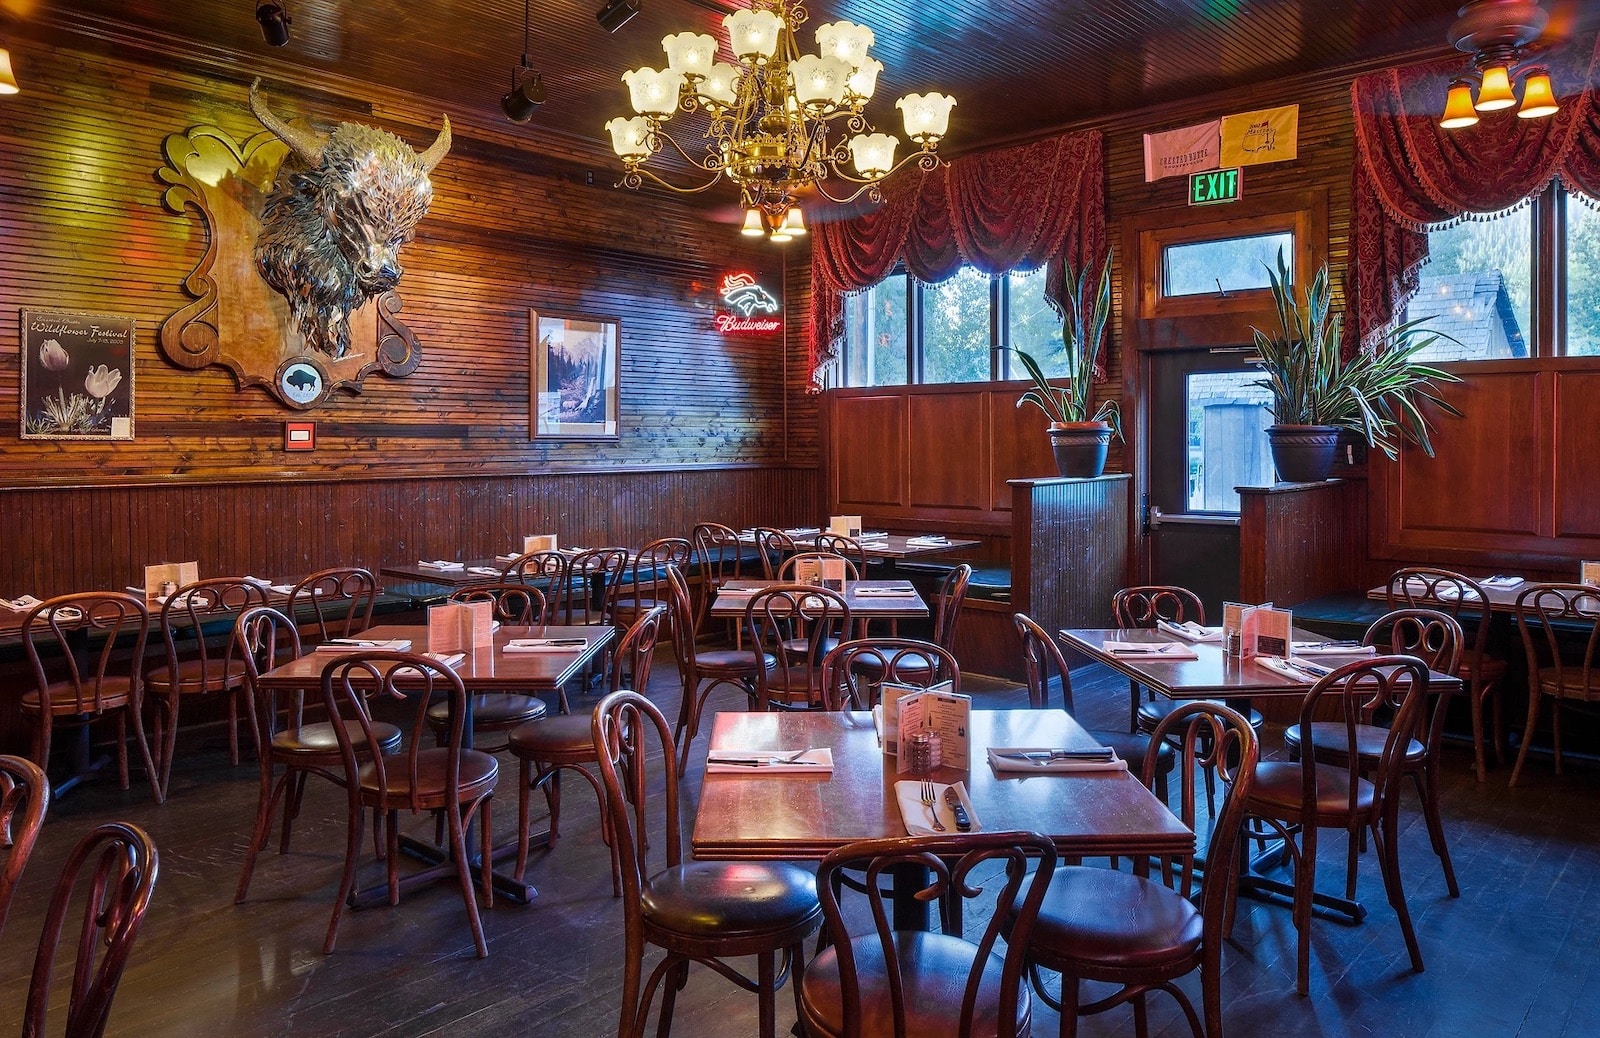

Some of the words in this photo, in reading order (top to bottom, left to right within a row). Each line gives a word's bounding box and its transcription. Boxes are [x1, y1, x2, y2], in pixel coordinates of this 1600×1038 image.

[1159, 154, 1188, 166] CRESTED
[1189, 148, 1208, 161] BUTTE
[1194, 171, 1238, 202] EXIT
[30, 321, 88, 337] Wildflower
[90, 325, 128, 338] Festival
[717, 315, 781, 332] Budweiser
